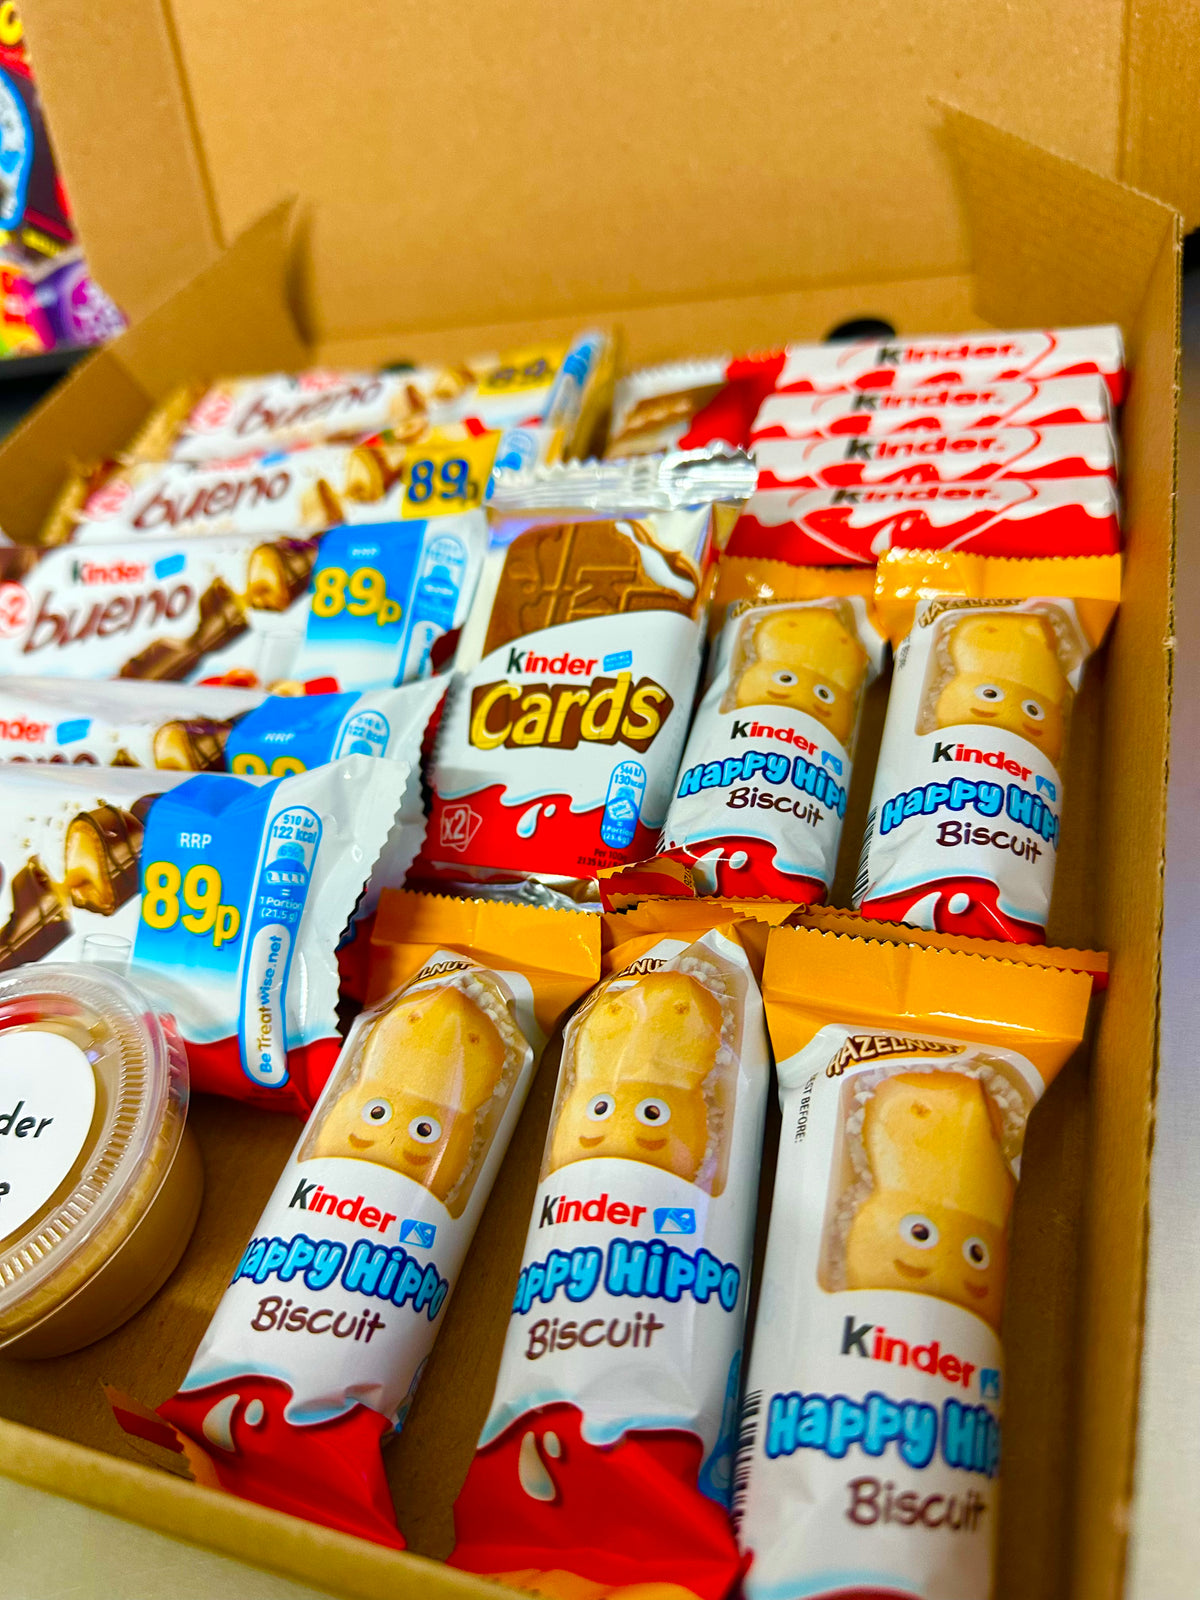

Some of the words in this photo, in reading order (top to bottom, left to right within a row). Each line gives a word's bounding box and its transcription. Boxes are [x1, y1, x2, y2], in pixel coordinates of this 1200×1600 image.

[133, 471, 291, 530] bueno
[23, 584, 195, 655] bueno
[311, 566, 402, 627] 89p
[0, 716, 50, 742] nder
[470, 671, 672, 752] Cards
[614, 774, 631, 786] 130
[677, 750, 791, 799] Happy
[725, 786, 824, 827] Biscuit
[879, 776, 1004, 835] Happy
[179, 832, 212, 849] RRP
[273, 825, 294, 840] 122
[936, 820, 1042, 864] Biscuit
[141, 860, 241, 948] 89p
[266, 896, 303, 909] Portion
[259, 1053, 273, 1073] Be
[826, 1035, 961, 1078] HAZELNUT
[0, 1100, 53, 1138] der
[512, 1246, 603, 1315] appy
[605, 1237, 741, 1312] Hippo
[250, 1295, 386, 1343] Biscuit
[526, 1311, 665, 1361] Biscuit
[765, 1391, 938, 1469] Happy
[846, 1475, 987, 1532] Biscuit
